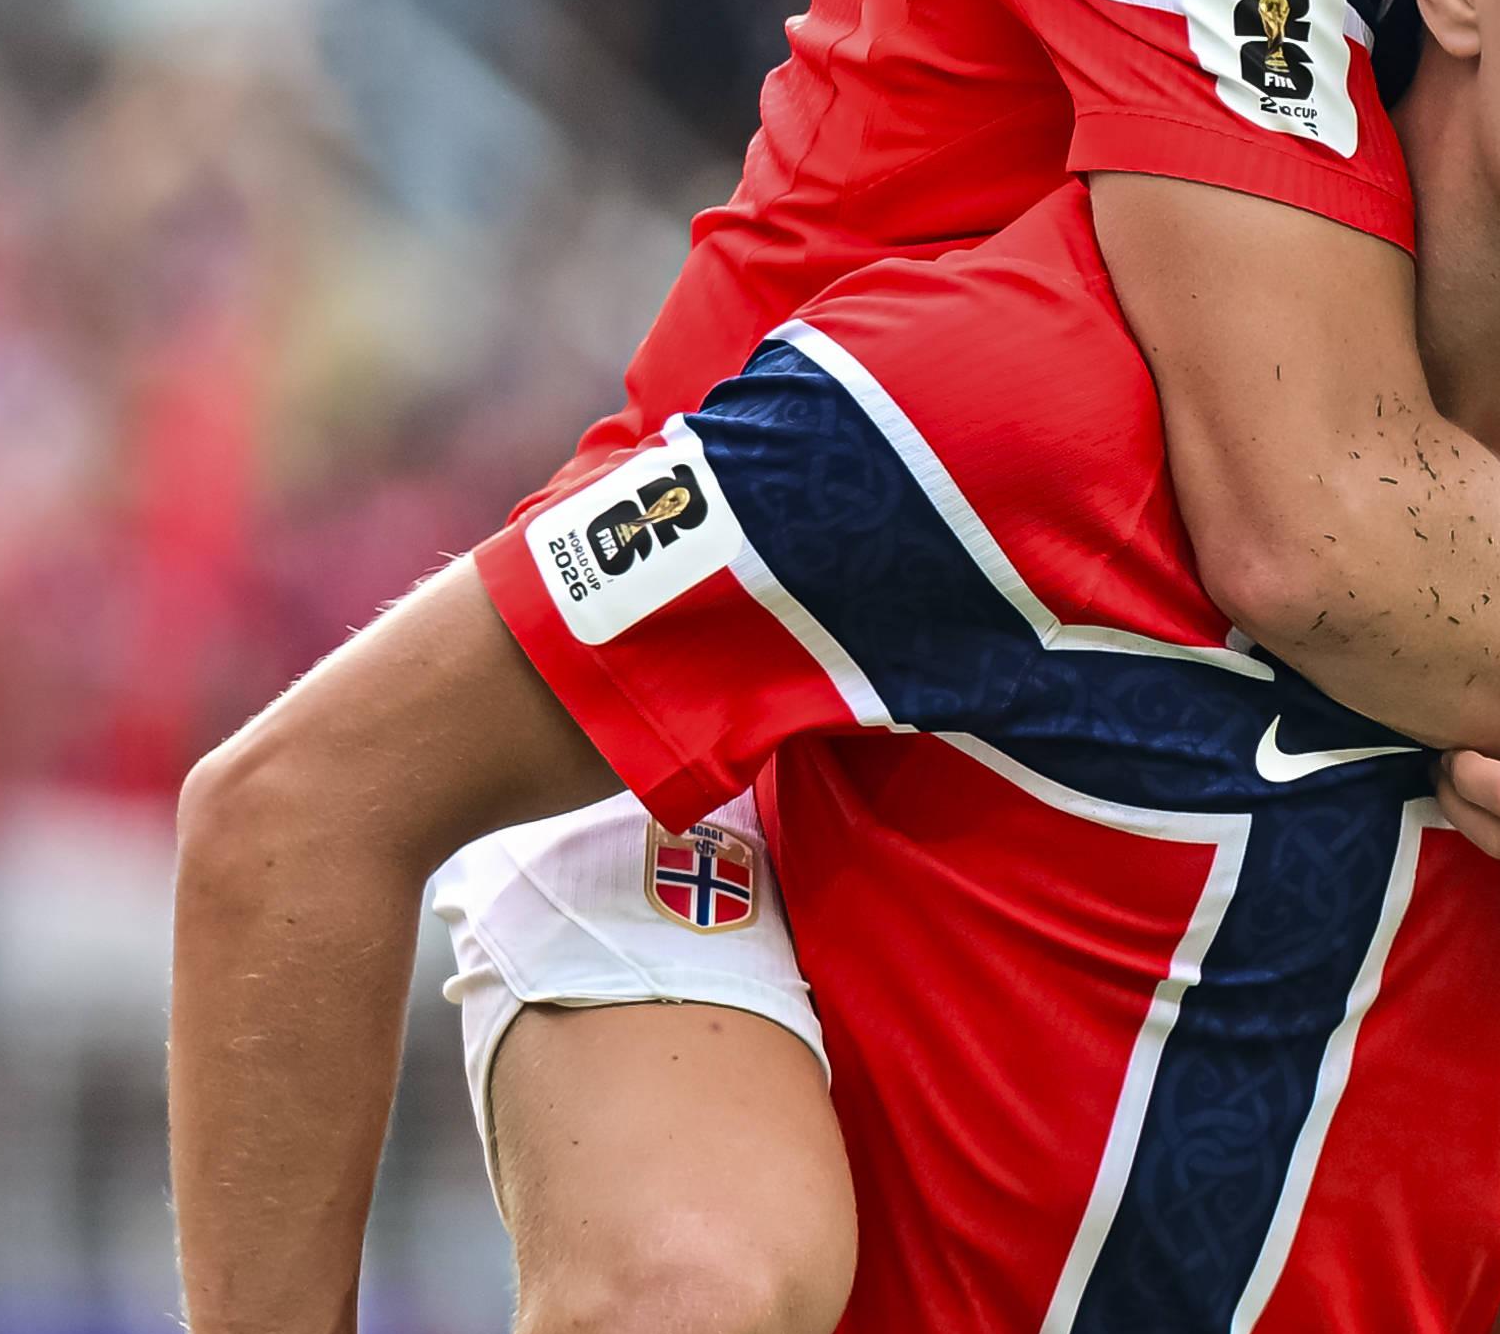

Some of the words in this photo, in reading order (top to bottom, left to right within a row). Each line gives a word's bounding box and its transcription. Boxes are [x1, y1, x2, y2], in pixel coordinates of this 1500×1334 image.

[548, 537, 589, 602] 2026
[567, 529, 589, 567] WORLD
[583, 567, 602, 591] CUP
